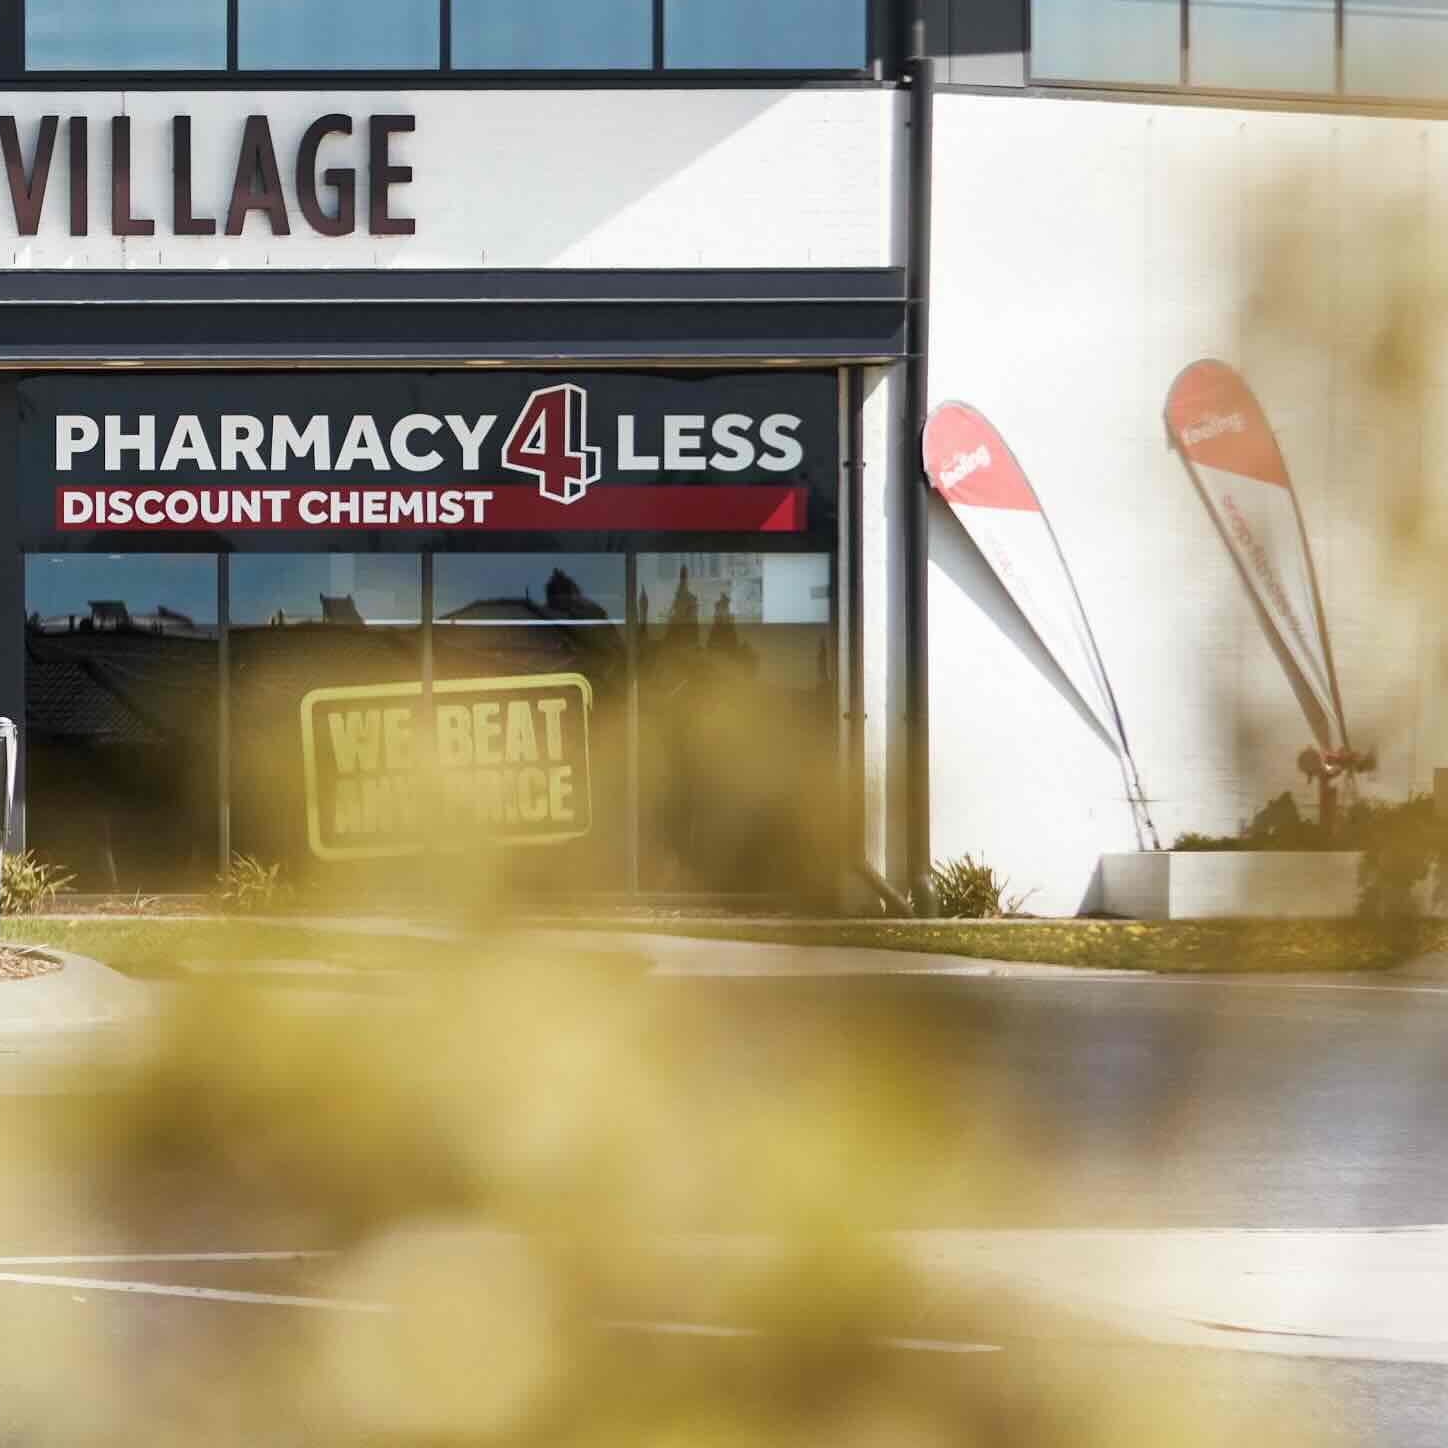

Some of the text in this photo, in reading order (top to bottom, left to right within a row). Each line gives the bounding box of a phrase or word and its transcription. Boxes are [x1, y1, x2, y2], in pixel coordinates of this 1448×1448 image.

[54, 382, 804, 506] PHARMACY 4 LESS
[62, 489, 494, 525] DISCOUNT CHEMIST
[327, 697, 568, 773] WE BEAT
